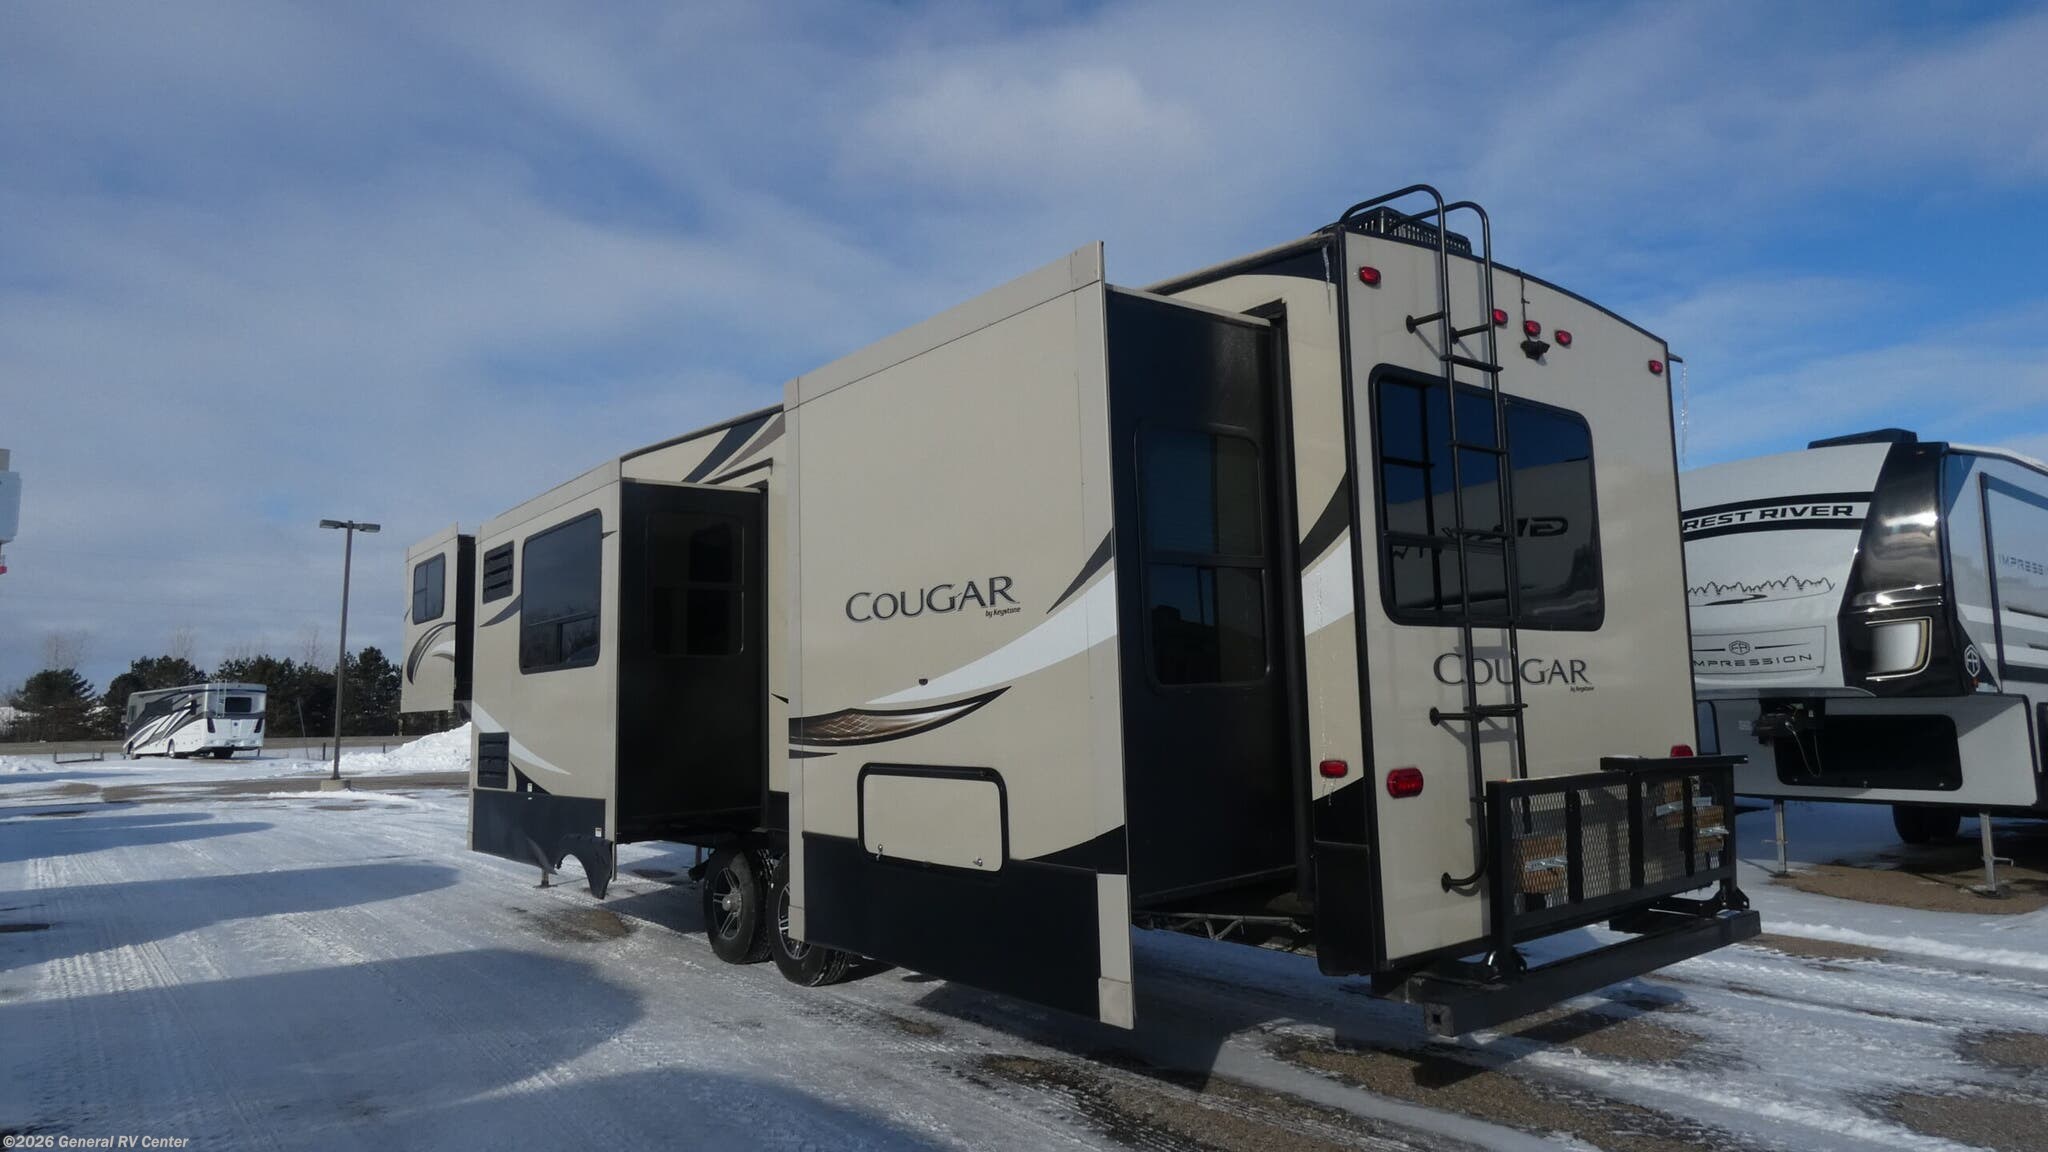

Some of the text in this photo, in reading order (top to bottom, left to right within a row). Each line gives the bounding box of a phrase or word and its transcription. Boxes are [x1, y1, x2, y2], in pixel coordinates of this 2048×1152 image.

[1759, 504, 1853, 520] RIVER
[845, 575, 1020, 623] COUGAR
[1433, 652, 1592, 686] COUGAR
